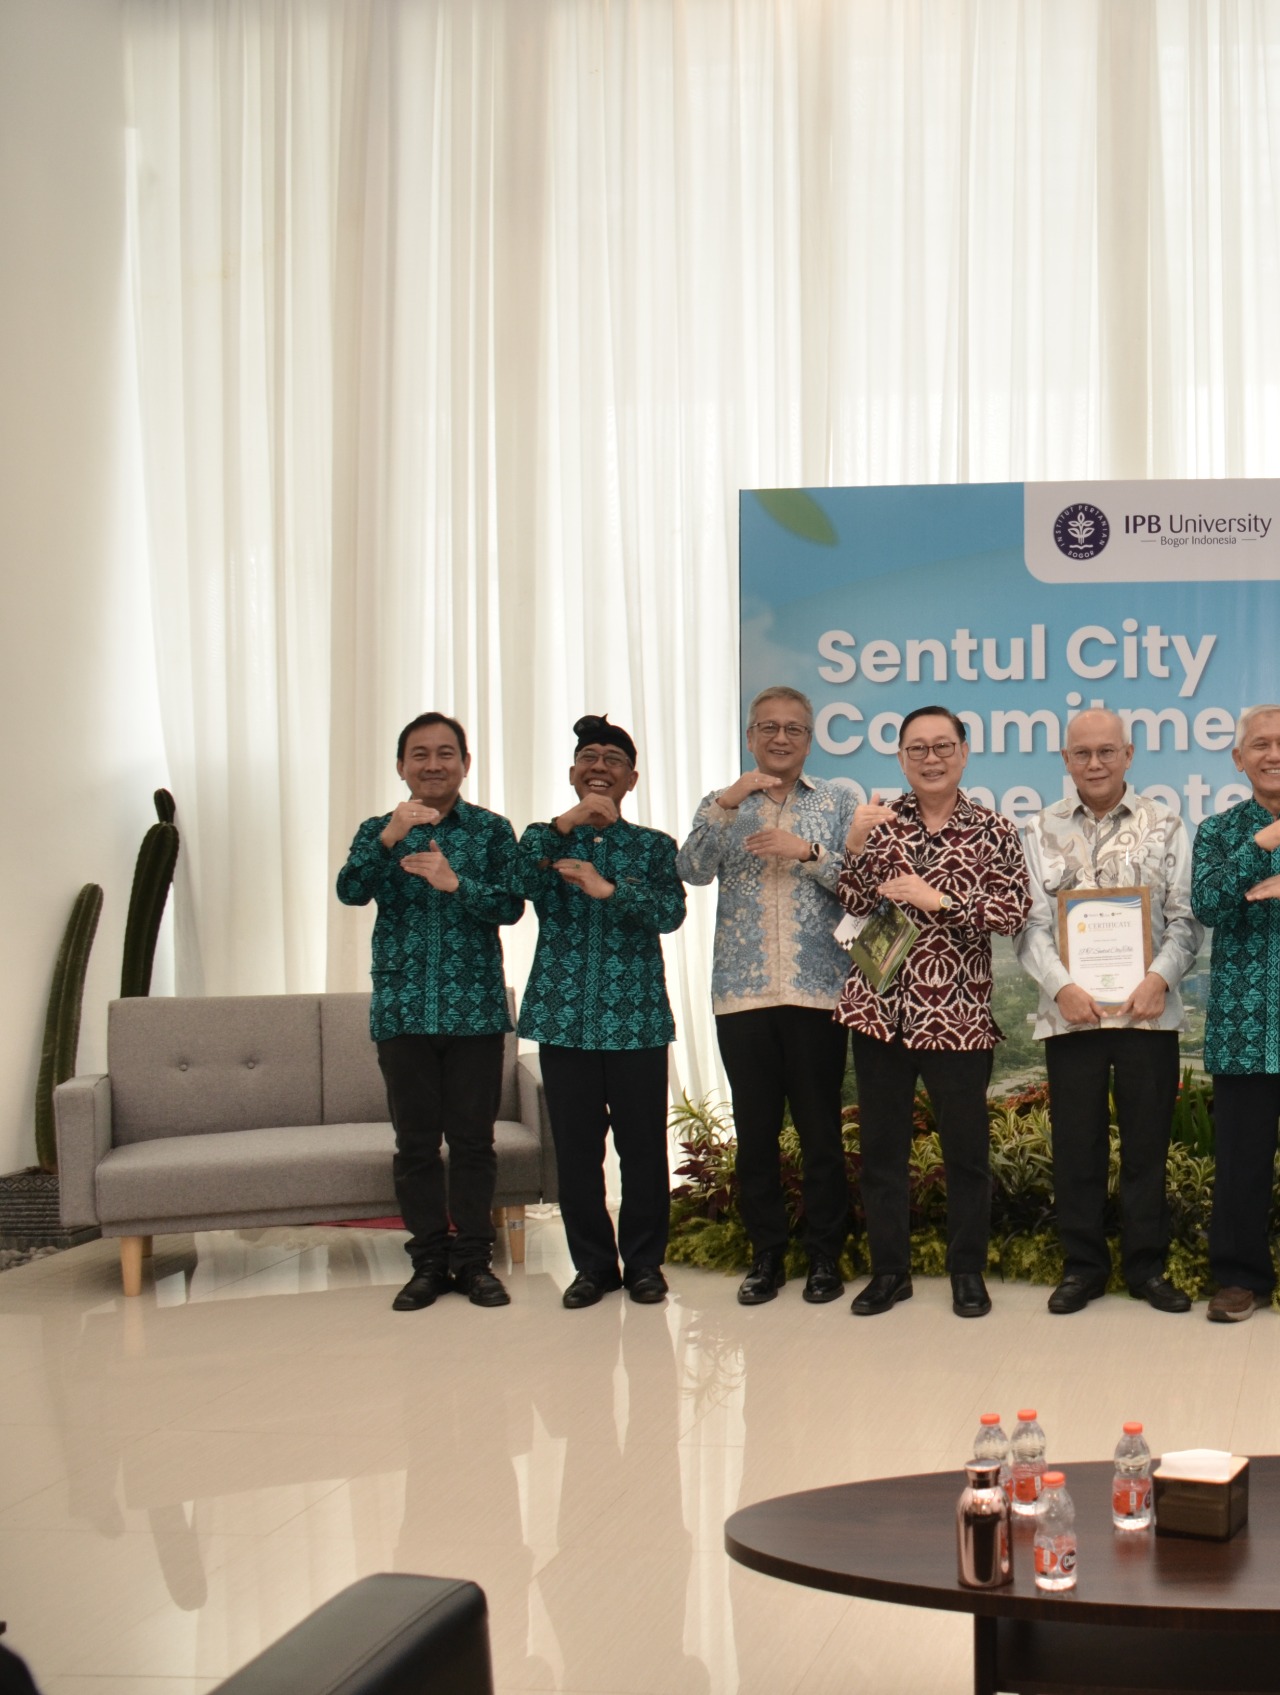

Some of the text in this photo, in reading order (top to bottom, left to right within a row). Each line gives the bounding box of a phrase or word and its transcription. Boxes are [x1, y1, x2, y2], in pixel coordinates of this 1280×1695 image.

[1125, 513, 1272, 538] IPB University
[1160, 535, 1236, 548] Bogor Indonesia
[1068, 550, 1094, 558] BOGOR
[817, 618, 1217, 697] Sentul City
